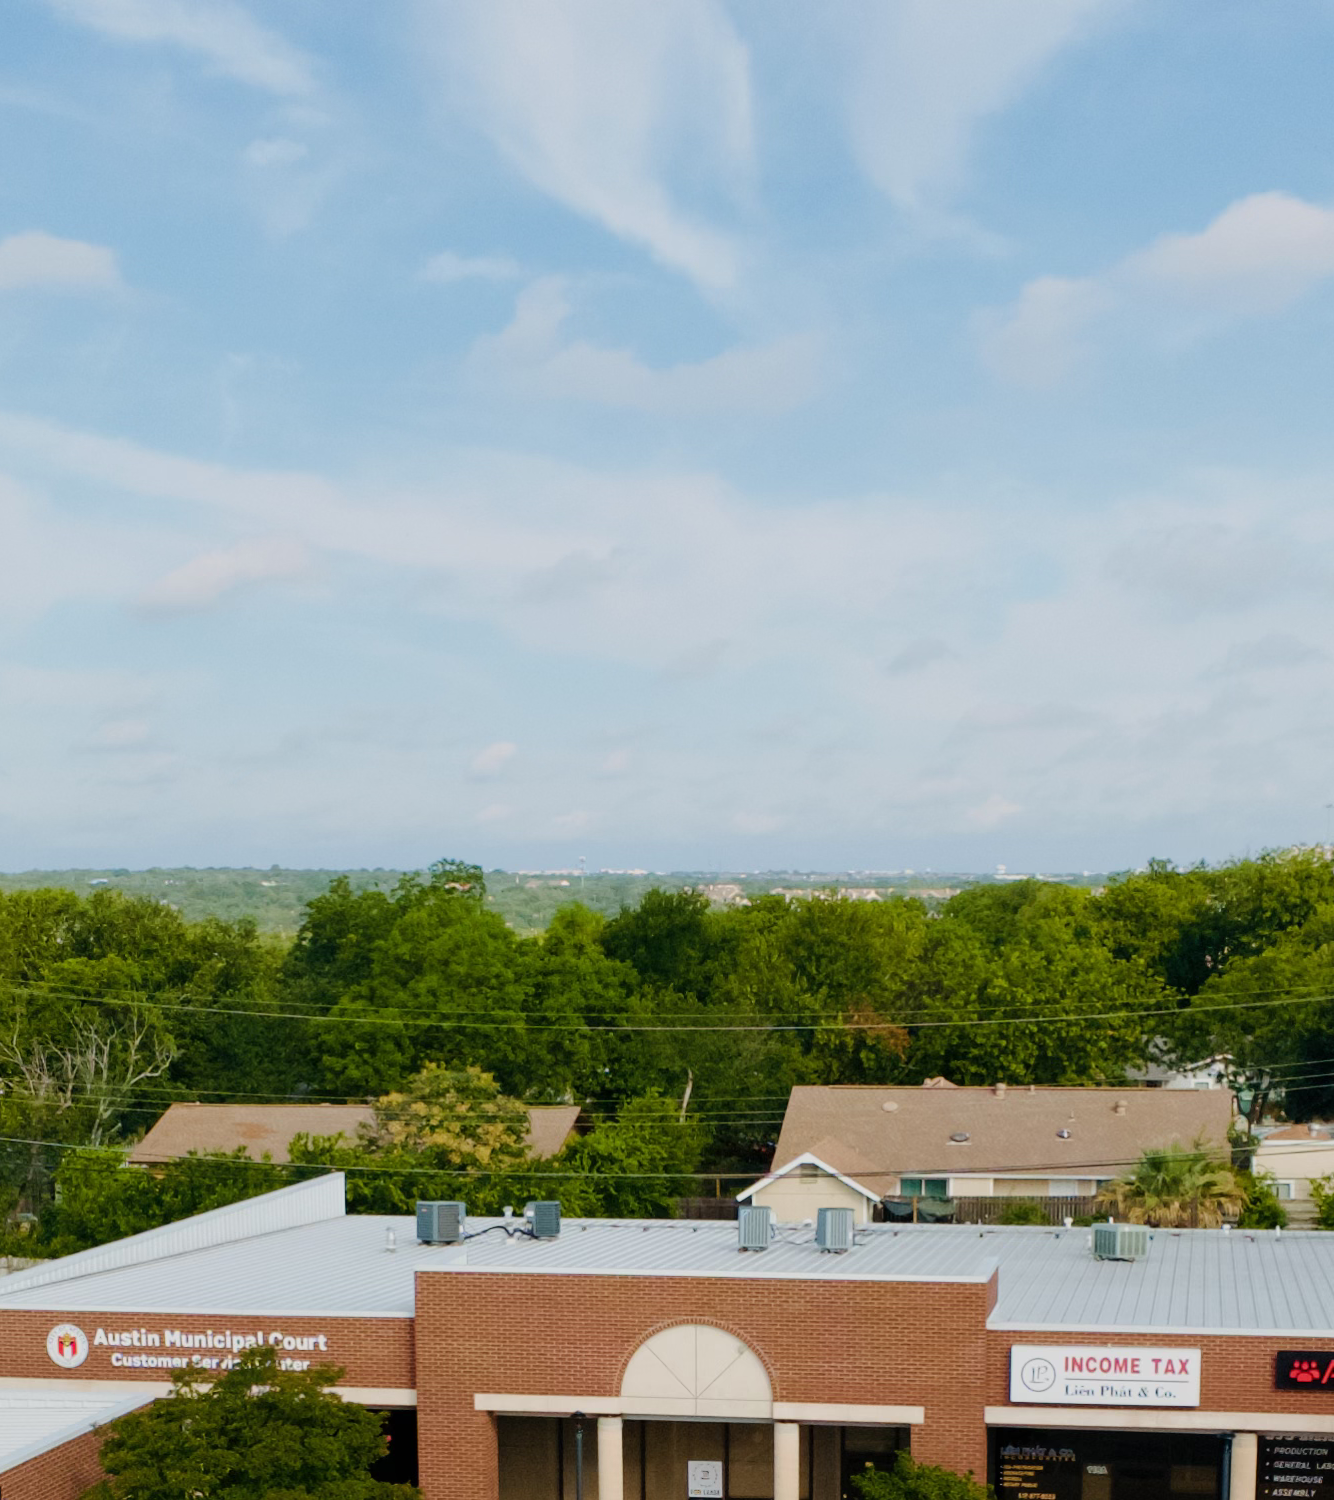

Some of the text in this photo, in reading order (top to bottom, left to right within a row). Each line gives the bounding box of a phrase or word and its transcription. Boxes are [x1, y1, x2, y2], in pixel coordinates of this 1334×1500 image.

[93, 1328, 160, 1348] Austin
[164, 1329, 264, 1353] Municipal
[268, 1332, 328, 1351] Court
[111, 1353, 190, 1369] Customer
[1064, 1357, 1190, 1375] INCOME TAX
[1138, 1386, 1149, 1398] &
[1155, 1386, 1177, 1398] Co.
[1274, 1446, 1328, 1455] PRODUCTION
[1273, 1461, 1311, 1469] GENERAL
[1273, 1475, 1323, 1484] WAREHOUSE
[1272, 1489, 1316, 1497] ASSEMBLY
